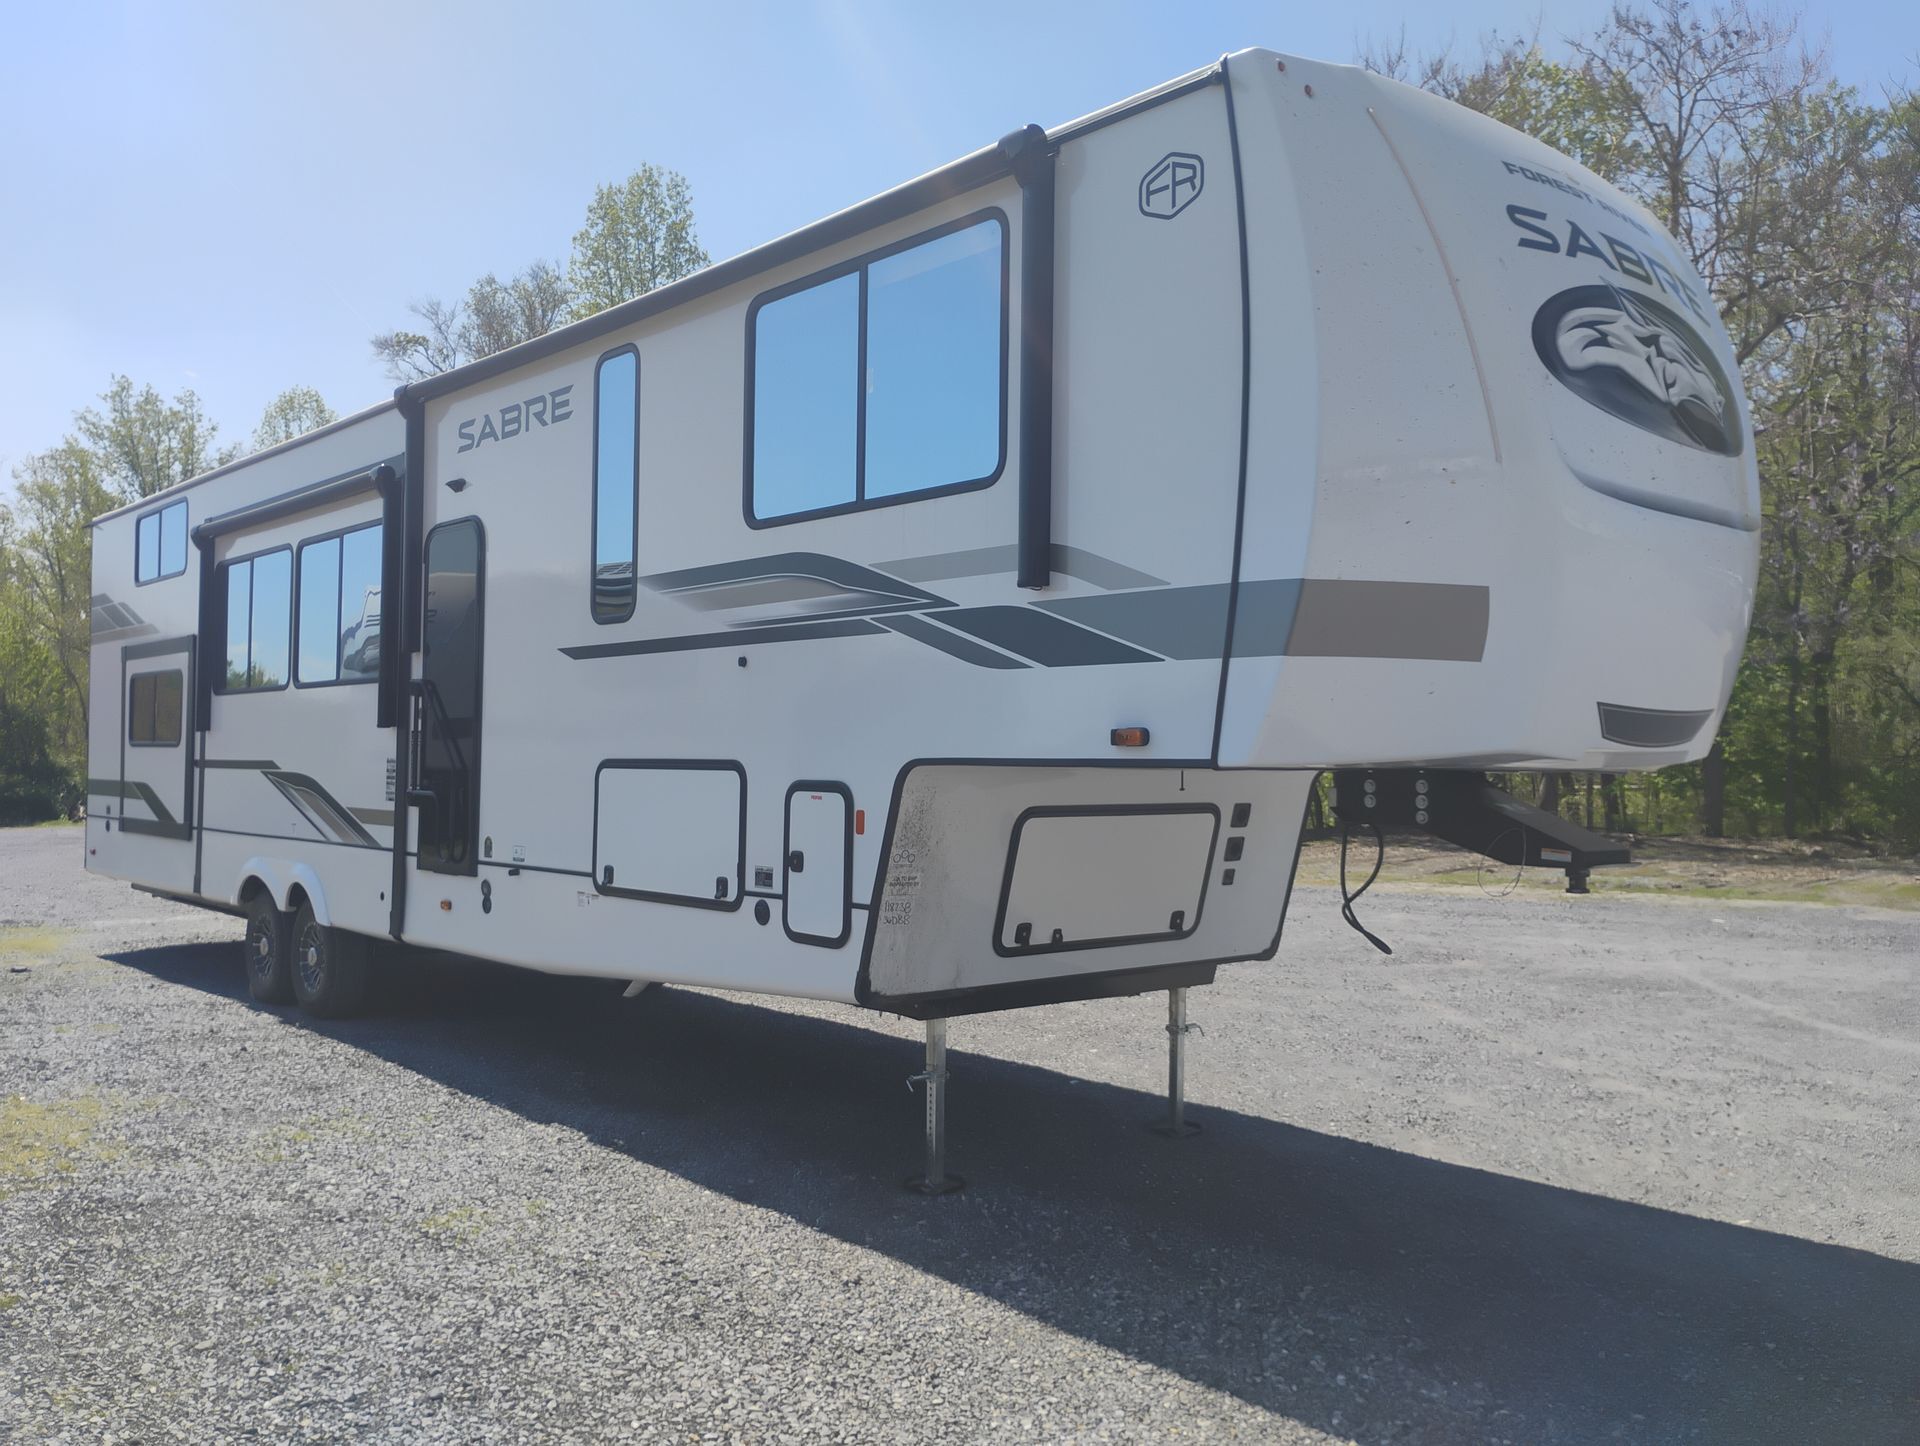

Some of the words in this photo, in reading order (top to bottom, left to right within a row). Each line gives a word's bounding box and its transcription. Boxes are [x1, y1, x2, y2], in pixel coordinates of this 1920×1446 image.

[1501, 160, 1594, 204] FOREST
[1506, 203, 1711, 328] SABRE
[457, 383, 575, 454] SABRE
